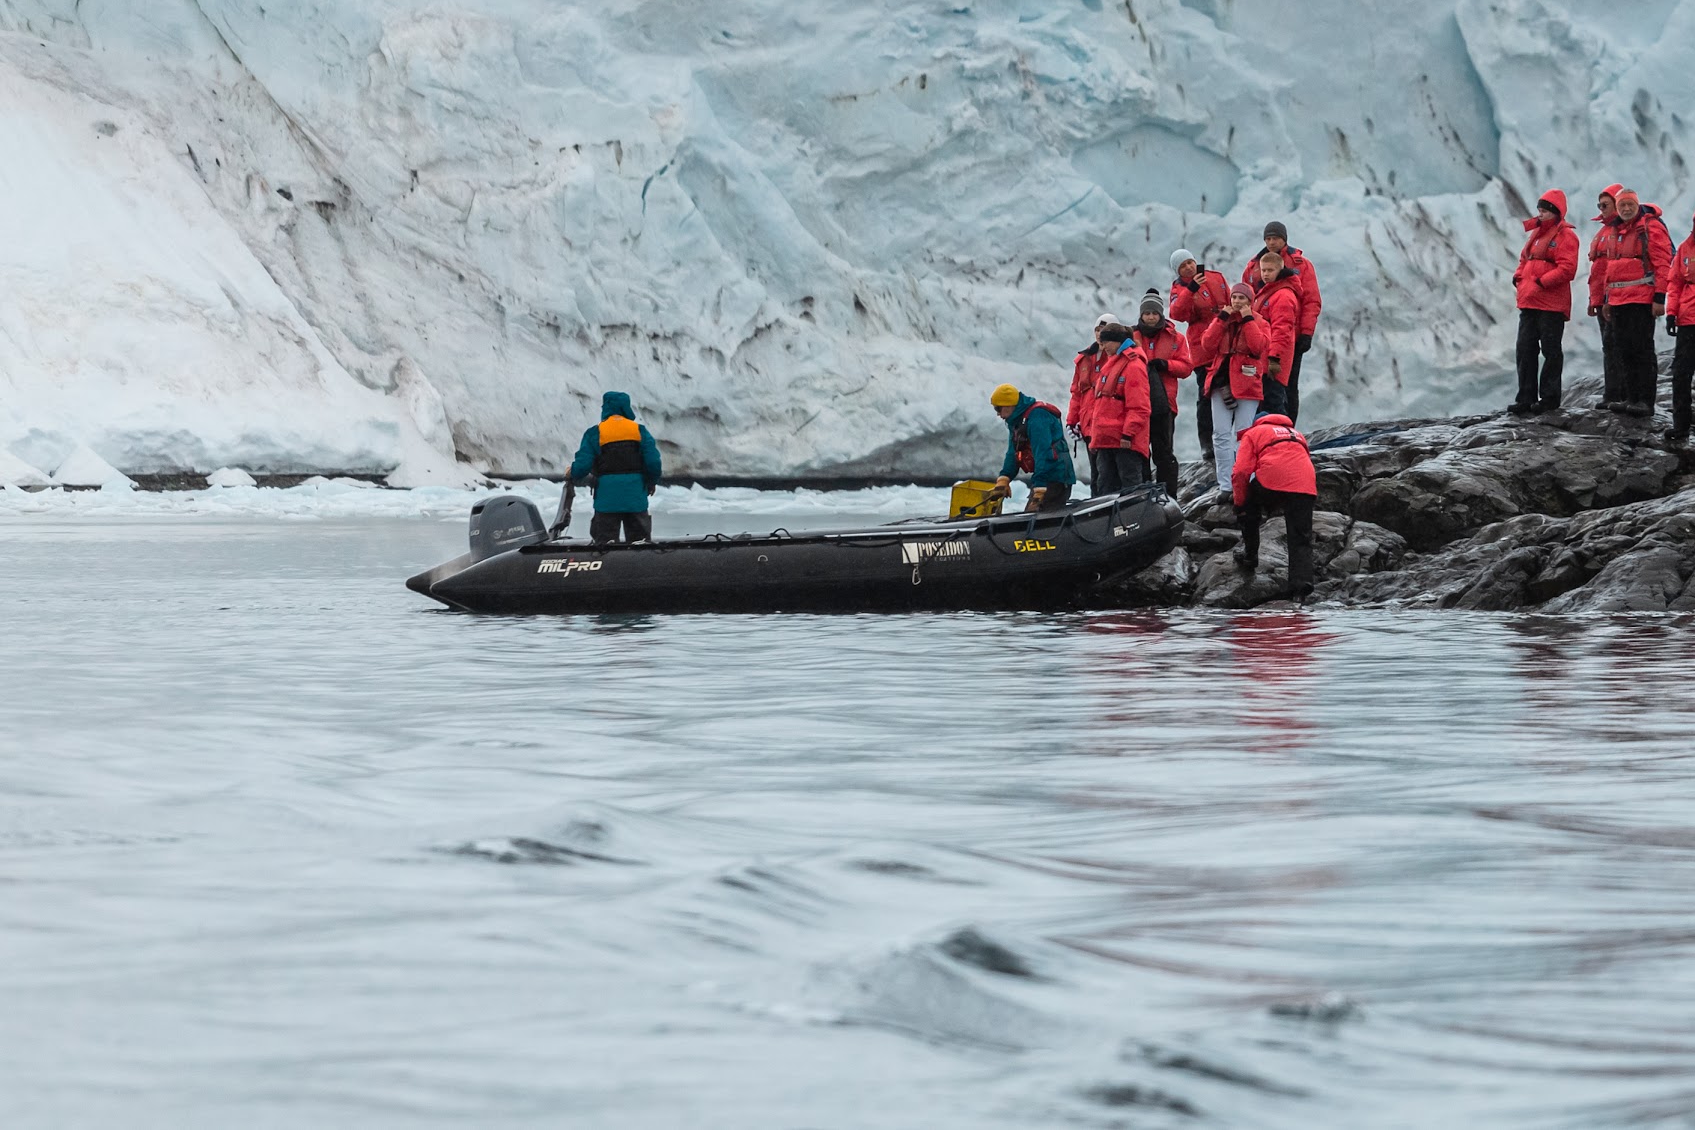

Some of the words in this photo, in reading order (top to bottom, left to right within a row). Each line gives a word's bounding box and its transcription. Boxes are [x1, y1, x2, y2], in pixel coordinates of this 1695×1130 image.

[918, 541, 971, 557] POSEIDON
[1014, 539, 1056, 553] BELL
[537, 561, 603, 577] MILPRO
